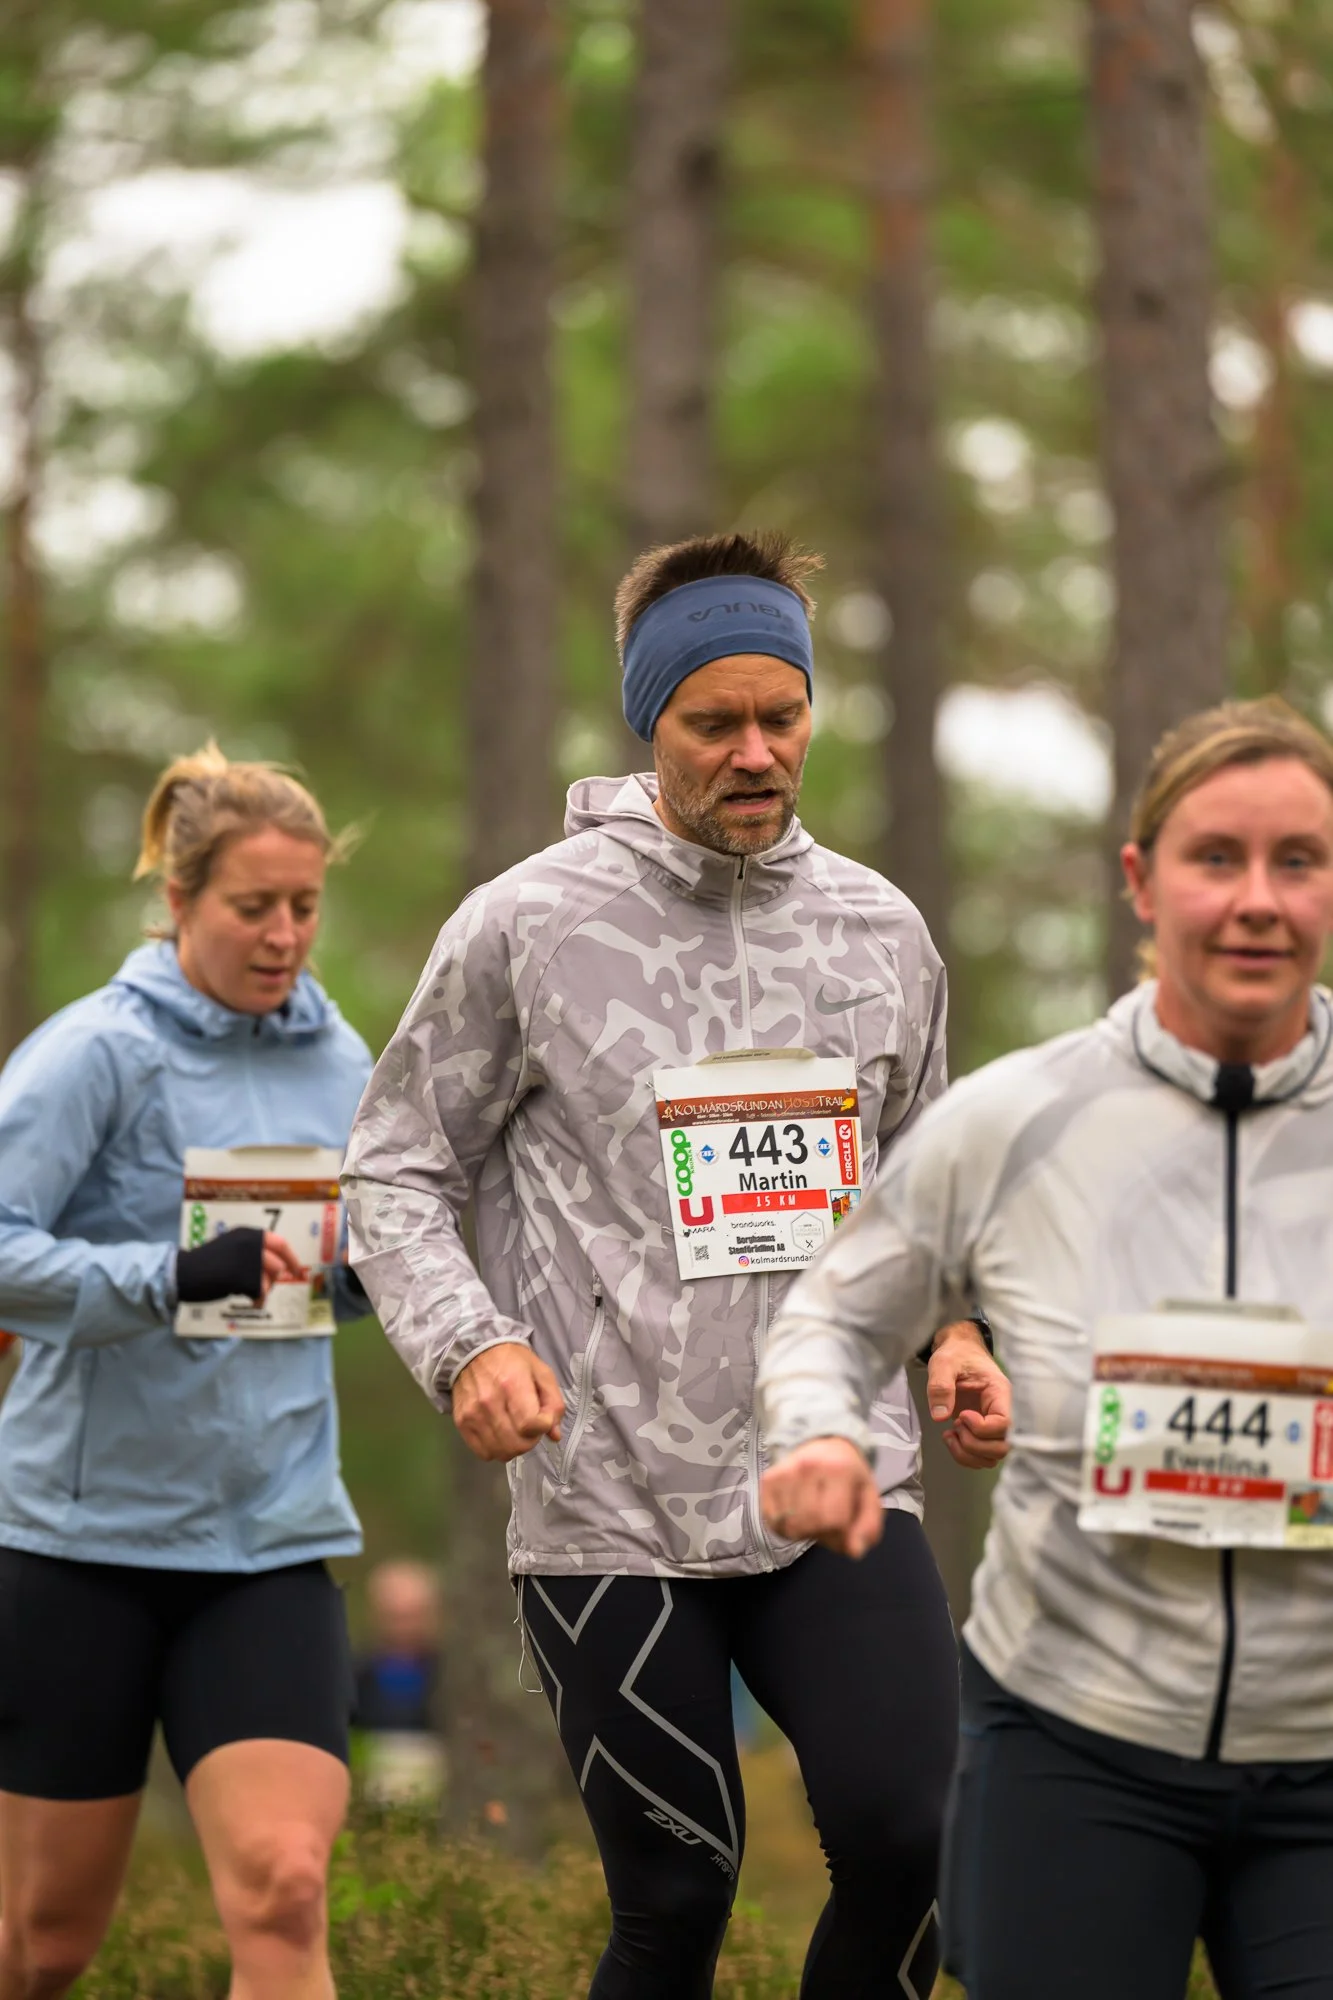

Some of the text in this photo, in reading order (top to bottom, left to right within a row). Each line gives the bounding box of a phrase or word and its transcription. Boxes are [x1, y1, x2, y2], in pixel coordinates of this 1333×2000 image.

[671, 1129, 693, 1196] coop
[729, 1123, 808, 1166] 443
[842, 1141, 853, 1180] CIRCLE
[739, 1170, 808, 1192] Martin
[756, 1194, 796, 1207] 15 KM
[750, 1253, 816, 1265] kolmardsrundan
[1167, 1395, 1270, 1447] 444
[643, 1808, 702, 1845] 2XU
